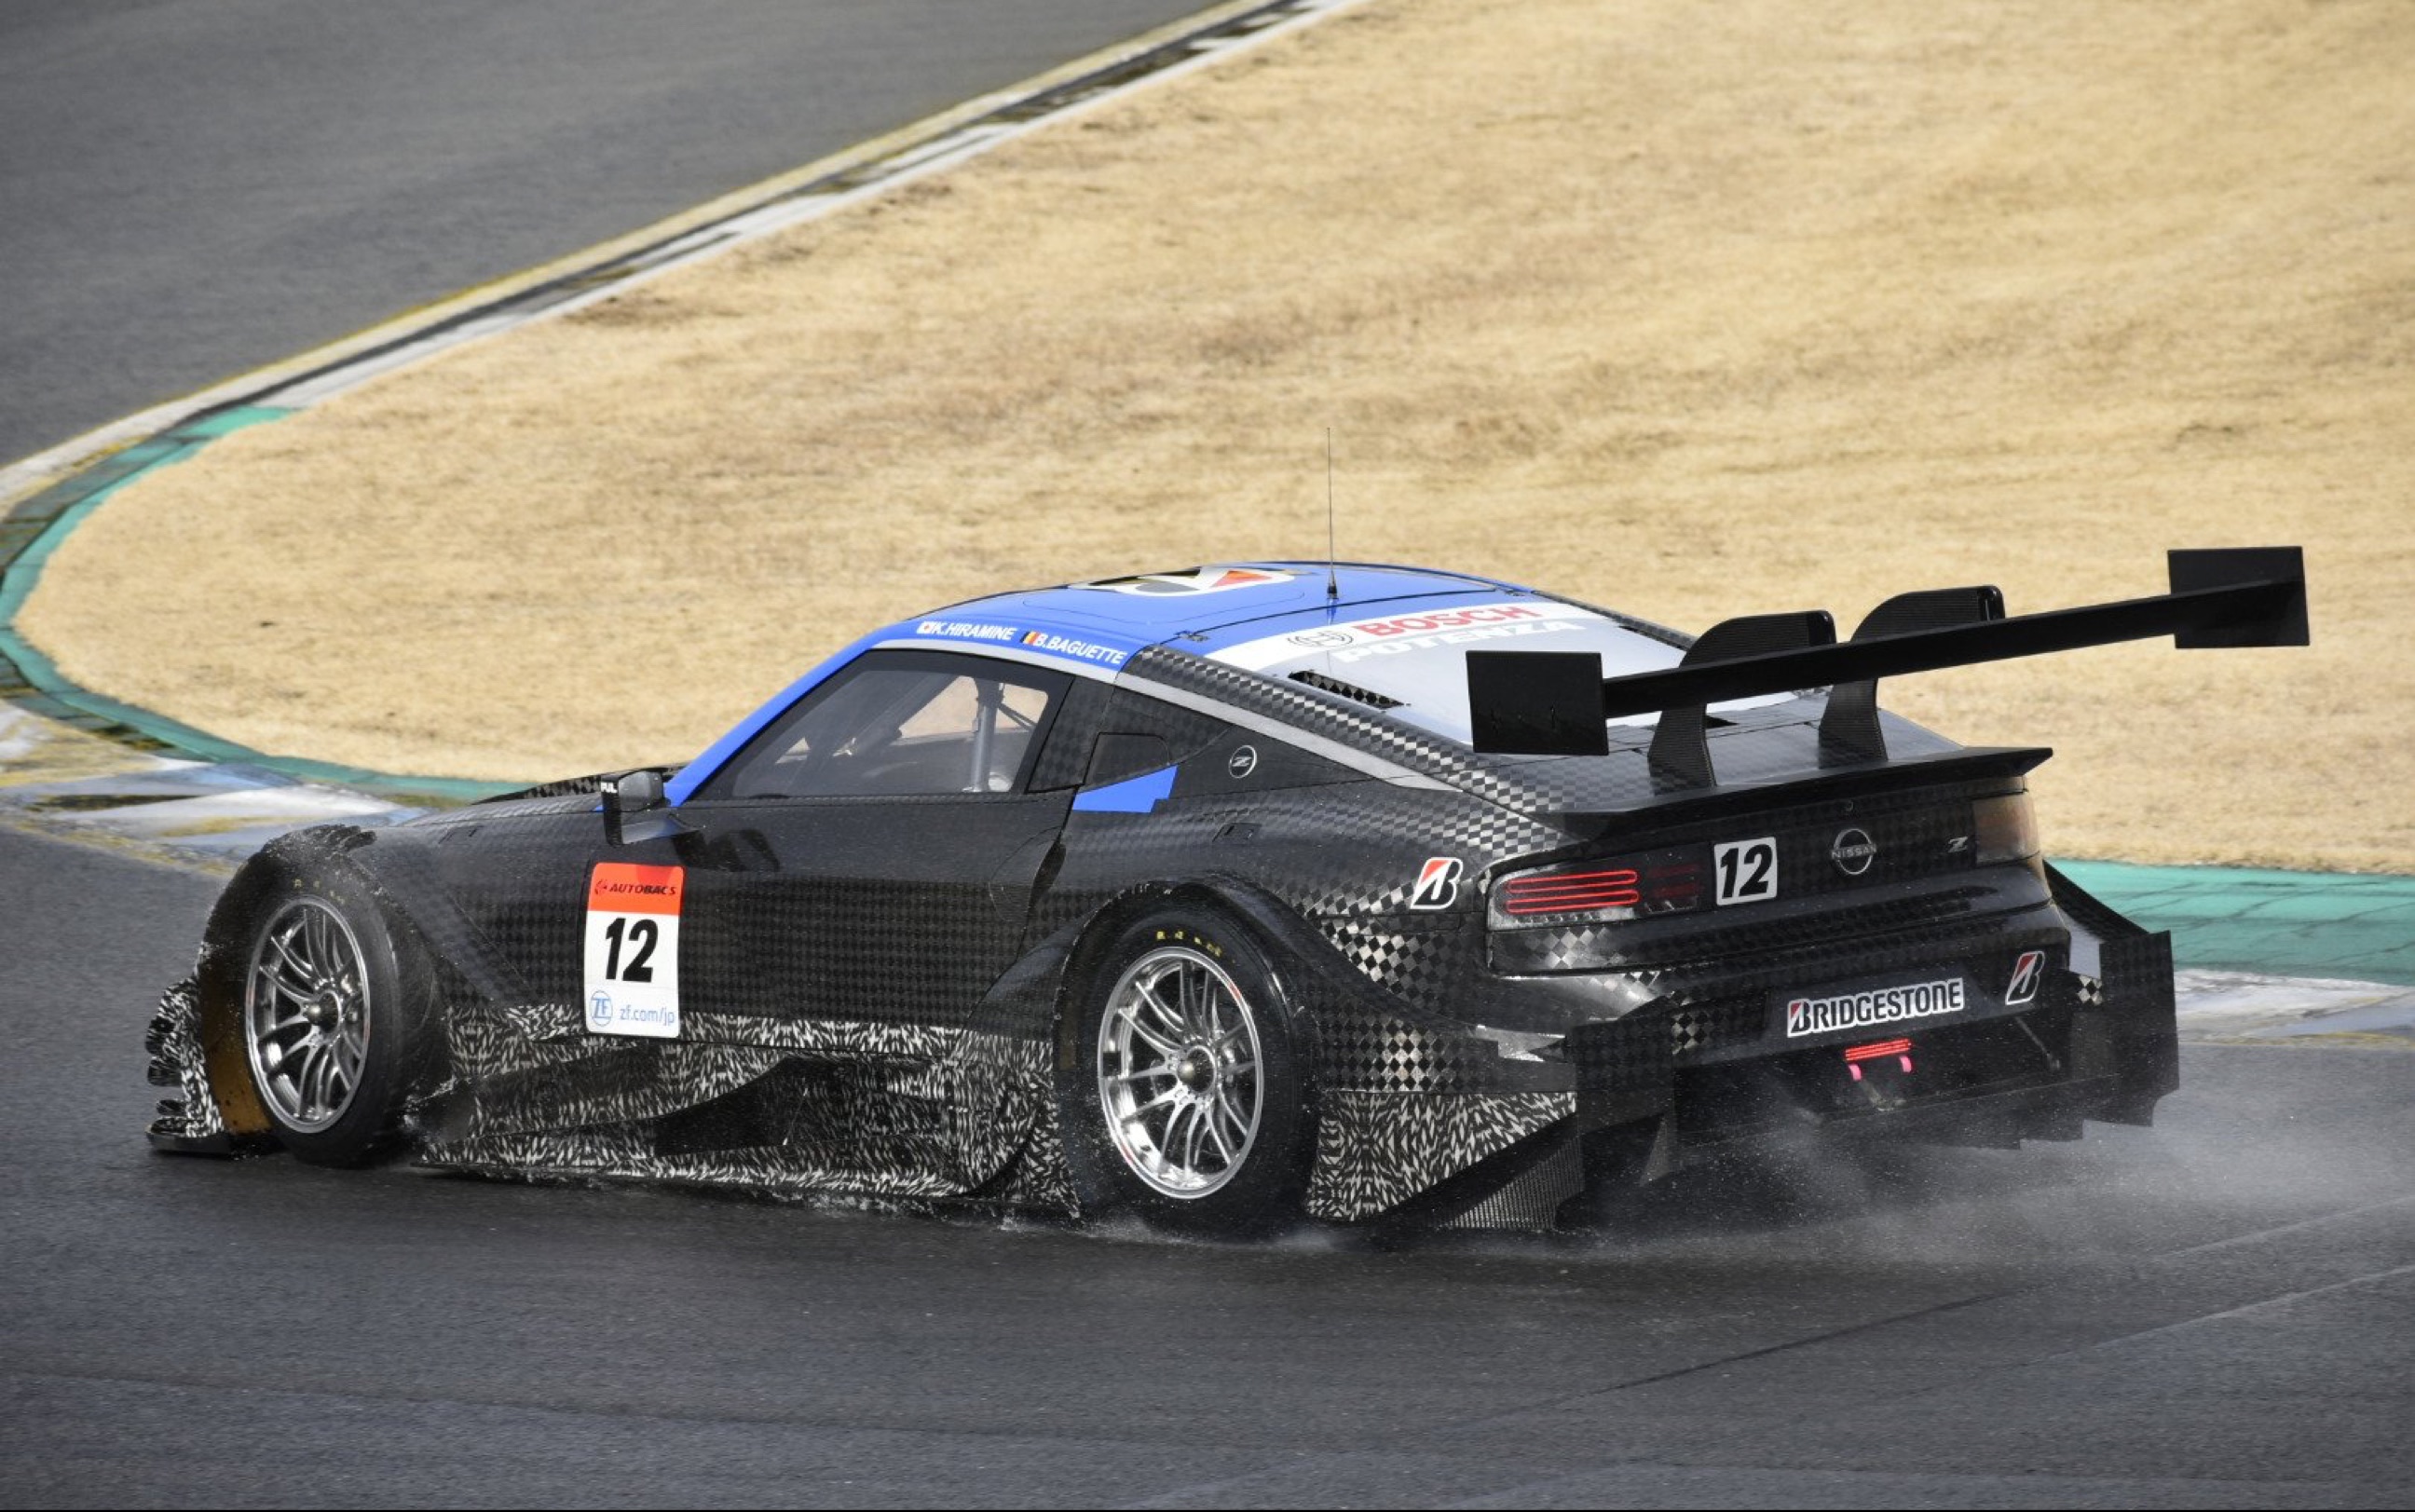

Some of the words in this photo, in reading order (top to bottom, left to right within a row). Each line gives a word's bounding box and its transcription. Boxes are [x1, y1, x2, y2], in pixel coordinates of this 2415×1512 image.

[933, 621, 1017, 641] K.HIRAMINE
[1033, 633, 1127, 664] B.BAGUETTE
[1332, 620, 1588, 663] POTENZA
[1351, 606, 1543, 636] BOSCH
[1720, 843, 1772, 899] 12
[1831, 843, 1877, 860] NISSAN
[609, 883, 677, 895] AUTOBACS
[606, 918, 659, 984] 12
[620, 1005, 675, 1027] zf.com/jp
[1788, 977, 1964, 1037] BRIDGESTONE
